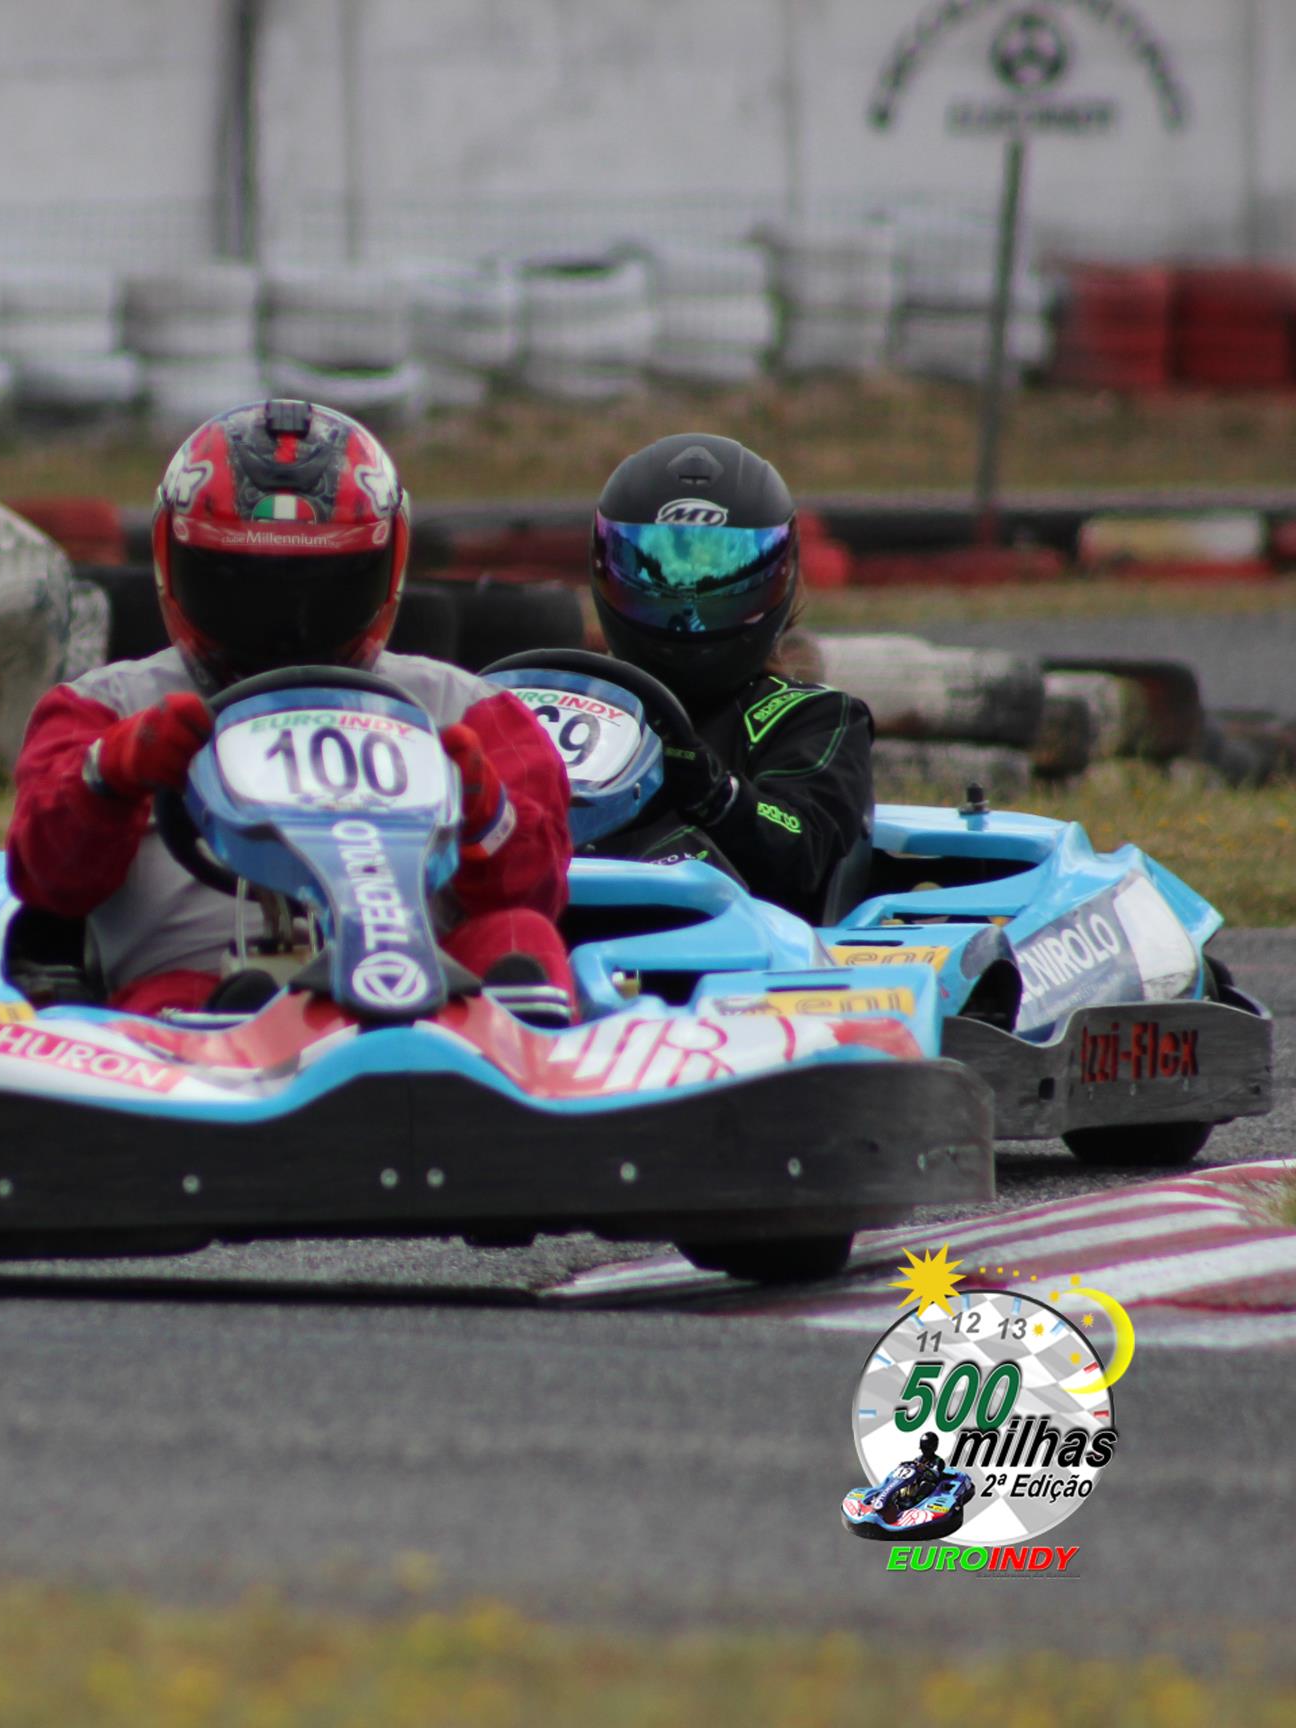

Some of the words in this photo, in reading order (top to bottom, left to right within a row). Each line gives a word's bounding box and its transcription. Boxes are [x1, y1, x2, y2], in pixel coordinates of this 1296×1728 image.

[246, 529, 329, 546] Millennium
[516, 691, 625, 721] ROINDY
[251, 712, 416, 735] EUROINDY
[264, 726, 408, 797] 100
[1021, 912, 1122, 1004] CNIROLO
